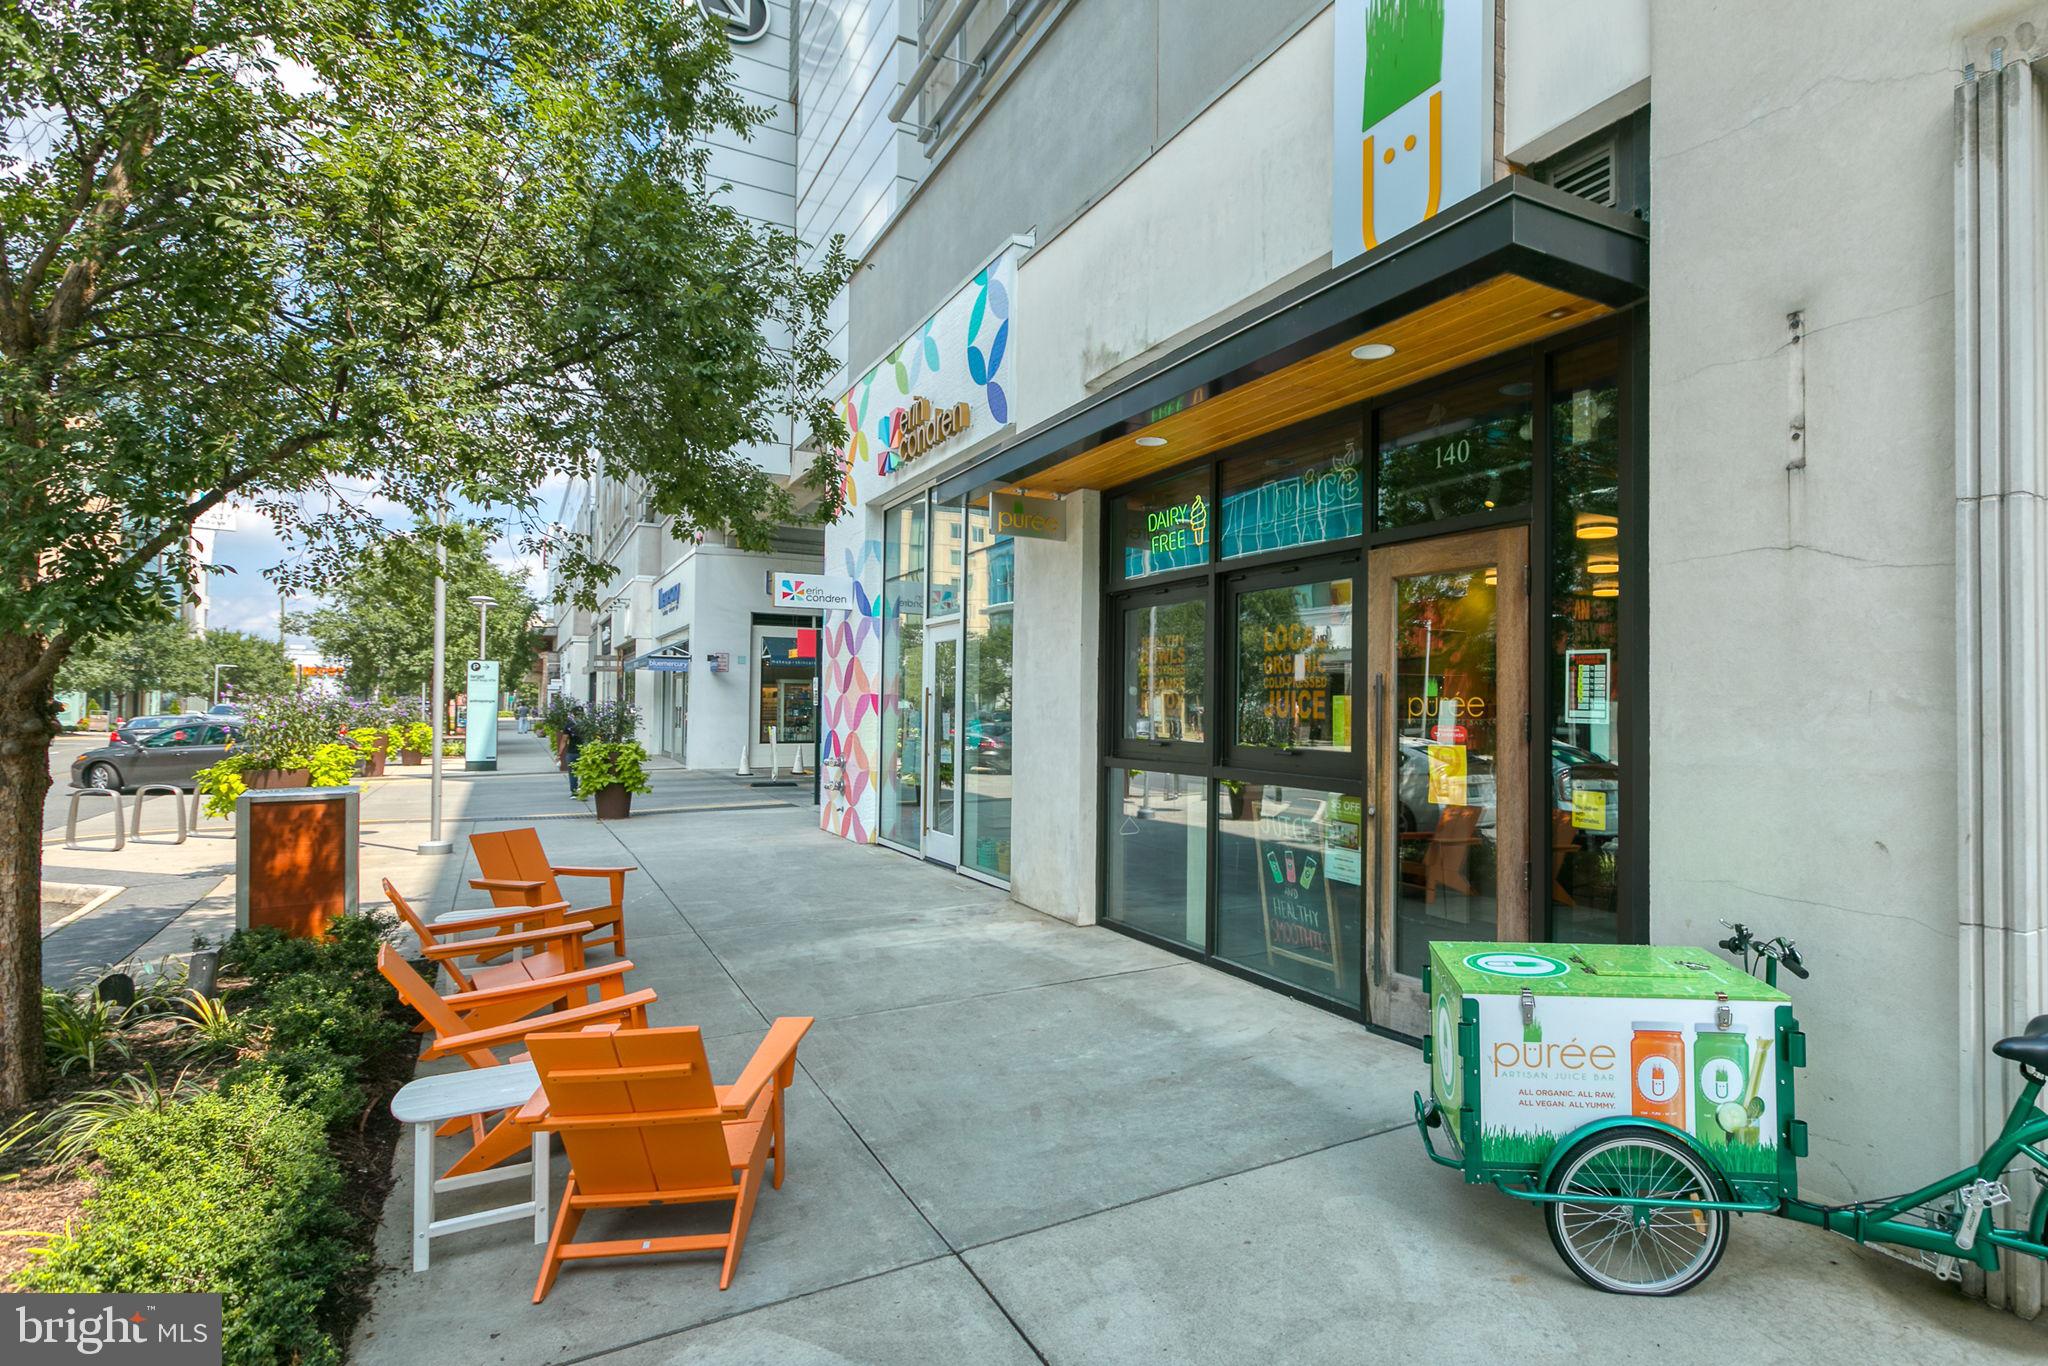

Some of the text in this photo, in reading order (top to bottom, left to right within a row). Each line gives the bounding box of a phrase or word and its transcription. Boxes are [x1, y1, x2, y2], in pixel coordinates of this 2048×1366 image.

[899, 401, 970, 463] condren
[1435, 439, 1470, 469] 140
[1148, 504, 1189, 533] DAIRY
[1151, 530, 1186, 555] FREE
[806, 587, 824, 595] erin
[805, 594, 847, 604] condren
[1263, 676, 1328, 689] COLD-PRESSED
[1263, 690, 1327, 720] JUICE
[1343, 801, 1362, 812] OFF
[1273, 896, 1319, 929] HEALTHY
[1501, 1071, 1616, 1081] ARTISAN JUICE BAR
[1518, 1088, 1616, 1099] ALL ORGANIC. ALL RAW.
[1518, 1099, 1616, 1110] ALL VEGAN. ALL YUMMY.
